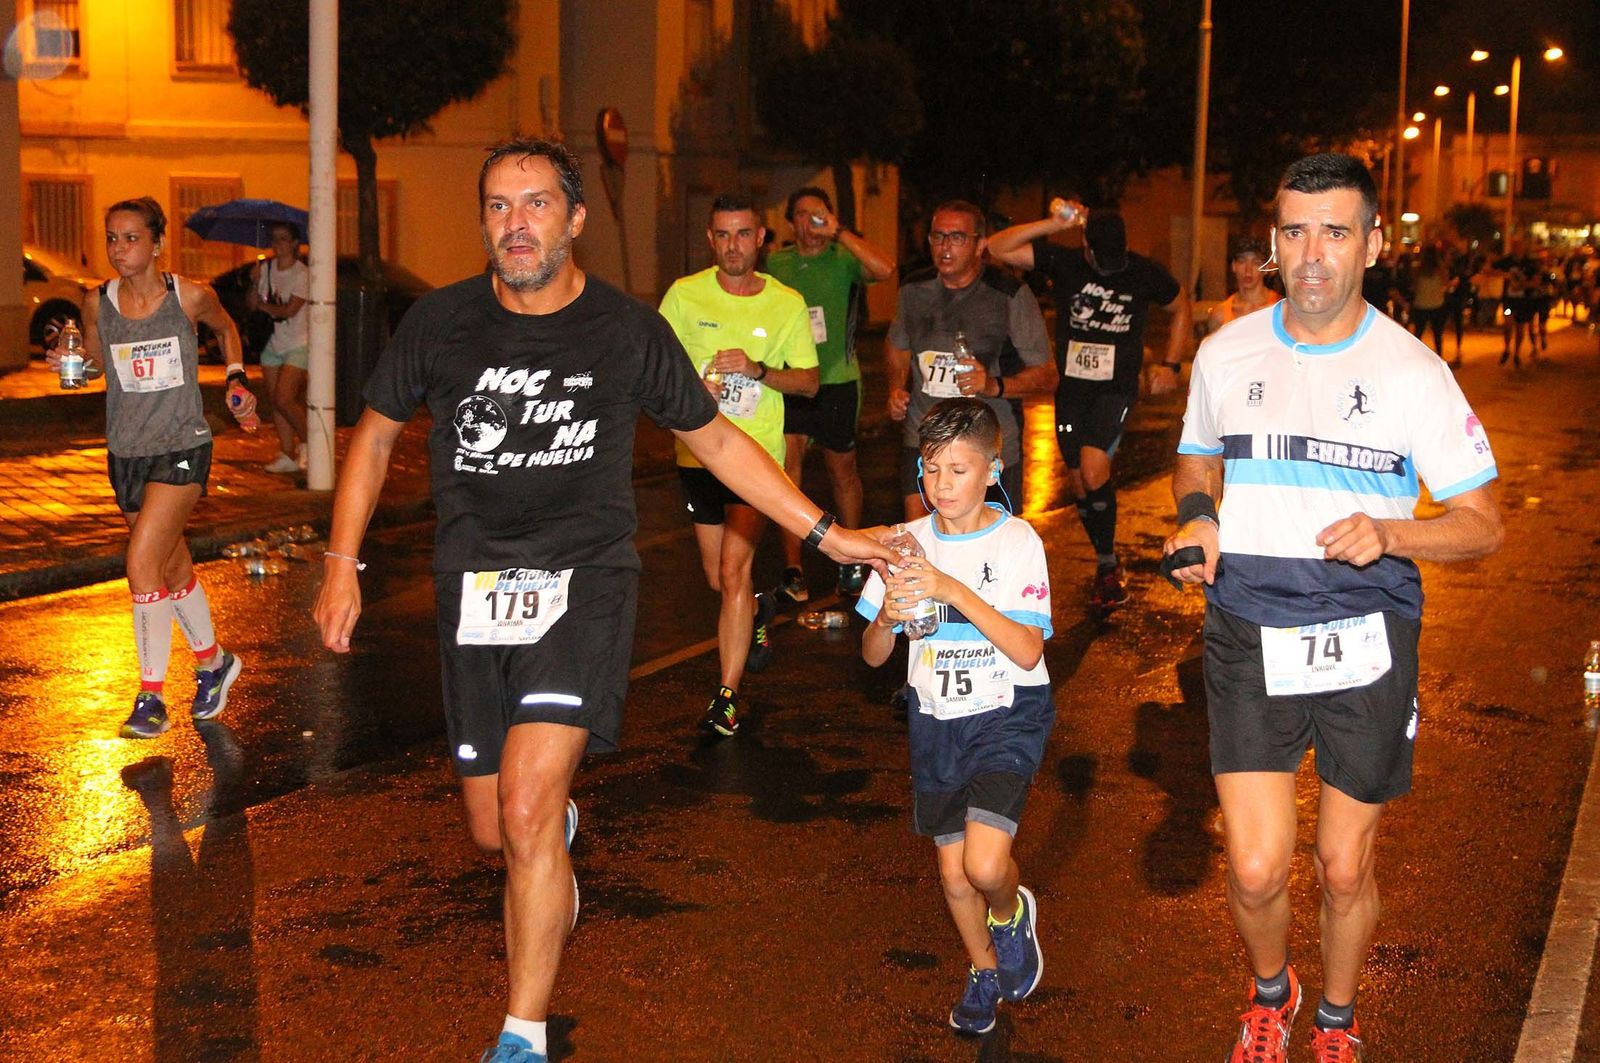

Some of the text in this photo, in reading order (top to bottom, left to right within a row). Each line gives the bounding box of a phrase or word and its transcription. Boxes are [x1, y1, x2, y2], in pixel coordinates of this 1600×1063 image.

[1081, 283, 1114, 299] NOC
[1100, 300, 1125, 313] TUR
[132, 341, 172, 353] NOCTURNA
[132, 358, 155, 378] 67
[1075, 354, 1100, 369] 465
[475, 366, 551, 396] NOC
[520, 400, 575, 424] TUR
[550, 418, 599, 450] NA
[497, 452, 526, 468] DE
[525, 446, 595, 468] HUELVA
[1306, 438, 1398, 473] ENRIQUE
[497, 569, 562, 581] NOCTURNA
[494, 580, 513, 592] DE
[513, 580, 559, 592] HUELVA
[485, 591, 540, 620] 179
[1320, 616, 1368, 632] HUELVA
[936, 645, 996, 660] NOCTURNA
[1300, 633, 1343, 666] 74
[934, 658, 951, 669] DE
[952, 656, 996, 669] HUELVA
[936, 670, 973, 697] 75
